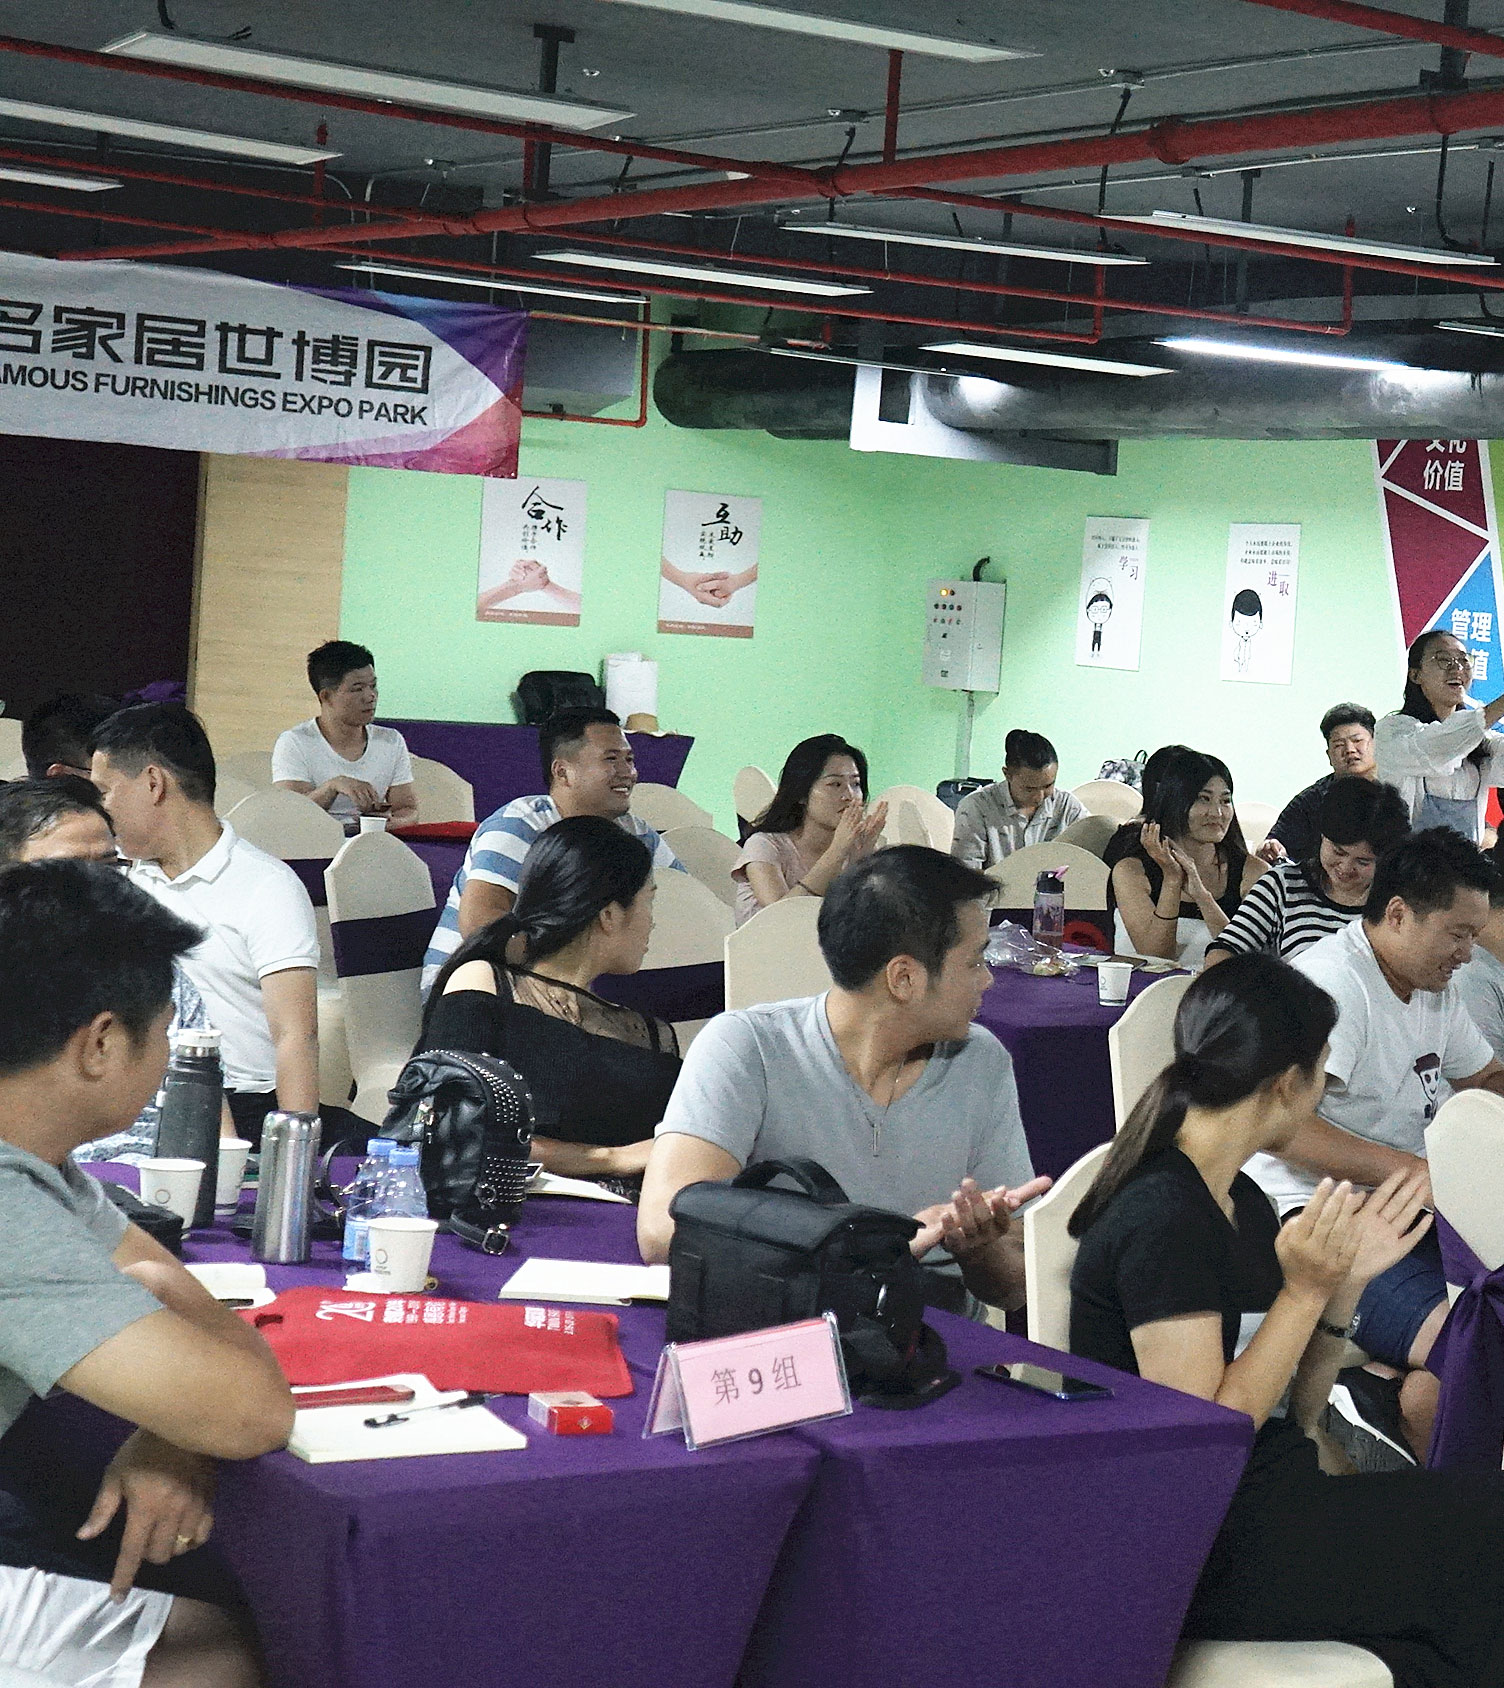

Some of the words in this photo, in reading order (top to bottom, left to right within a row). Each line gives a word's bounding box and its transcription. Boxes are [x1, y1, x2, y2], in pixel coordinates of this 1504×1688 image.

[0, 299, 433, 395] 名家居世博园
[0, 363, 88, 392] MOUS
[94, 372, 277, 411] FURNISHINGS
[281, 391, 353, 419] EXPO
[358, 399, 428, 426] PARK
[1423, 460, 1465, 491] 价值
[521, 485, 568, 541] 合作
[701, 502, 743, 546] 互助
[1451, 608, 1492, 643] 管理
[710, 1355, 802, 1407] 第9组
